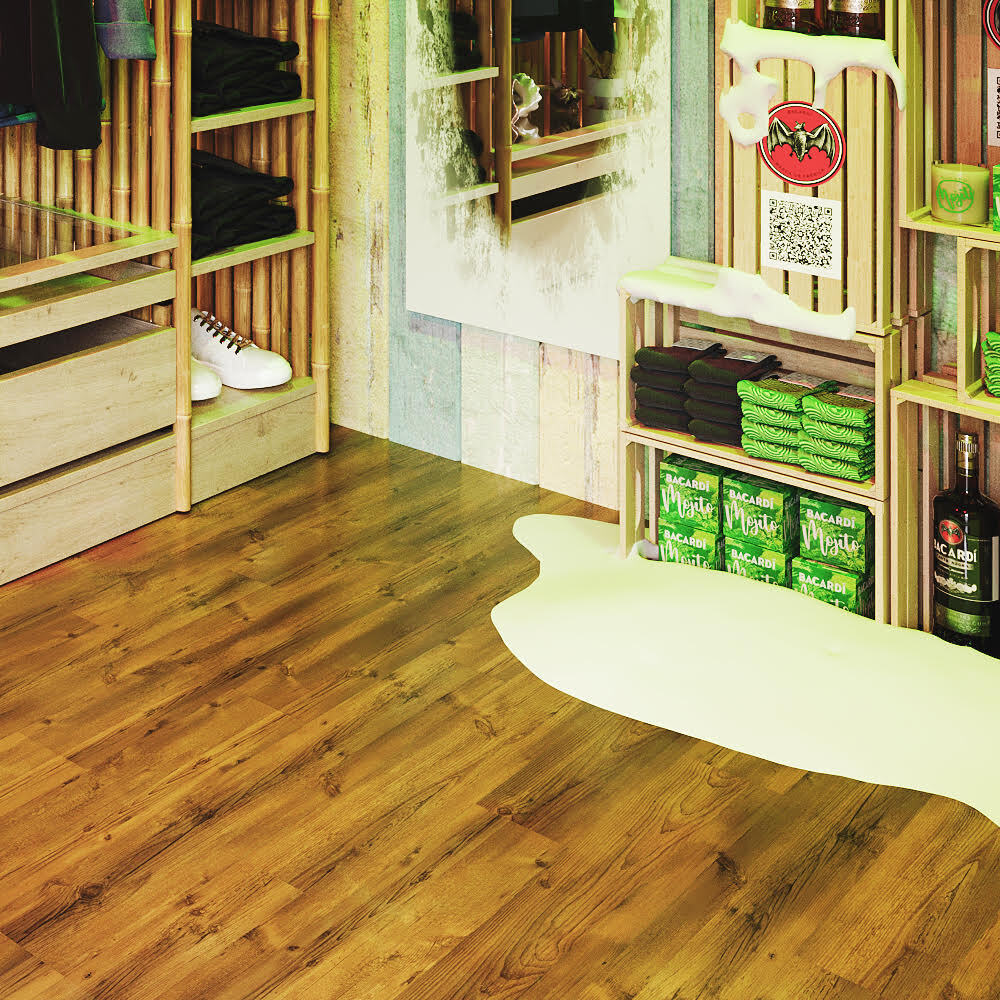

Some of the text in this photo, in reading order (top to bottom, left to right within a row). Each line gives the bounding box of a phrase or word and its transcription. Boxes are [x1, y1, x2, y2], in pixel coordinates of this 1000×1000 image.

[662, 484, 715, 519] Mojito
[725, 500, 780, 536] Mojito
[802, 519, 862, 556] Mojito
